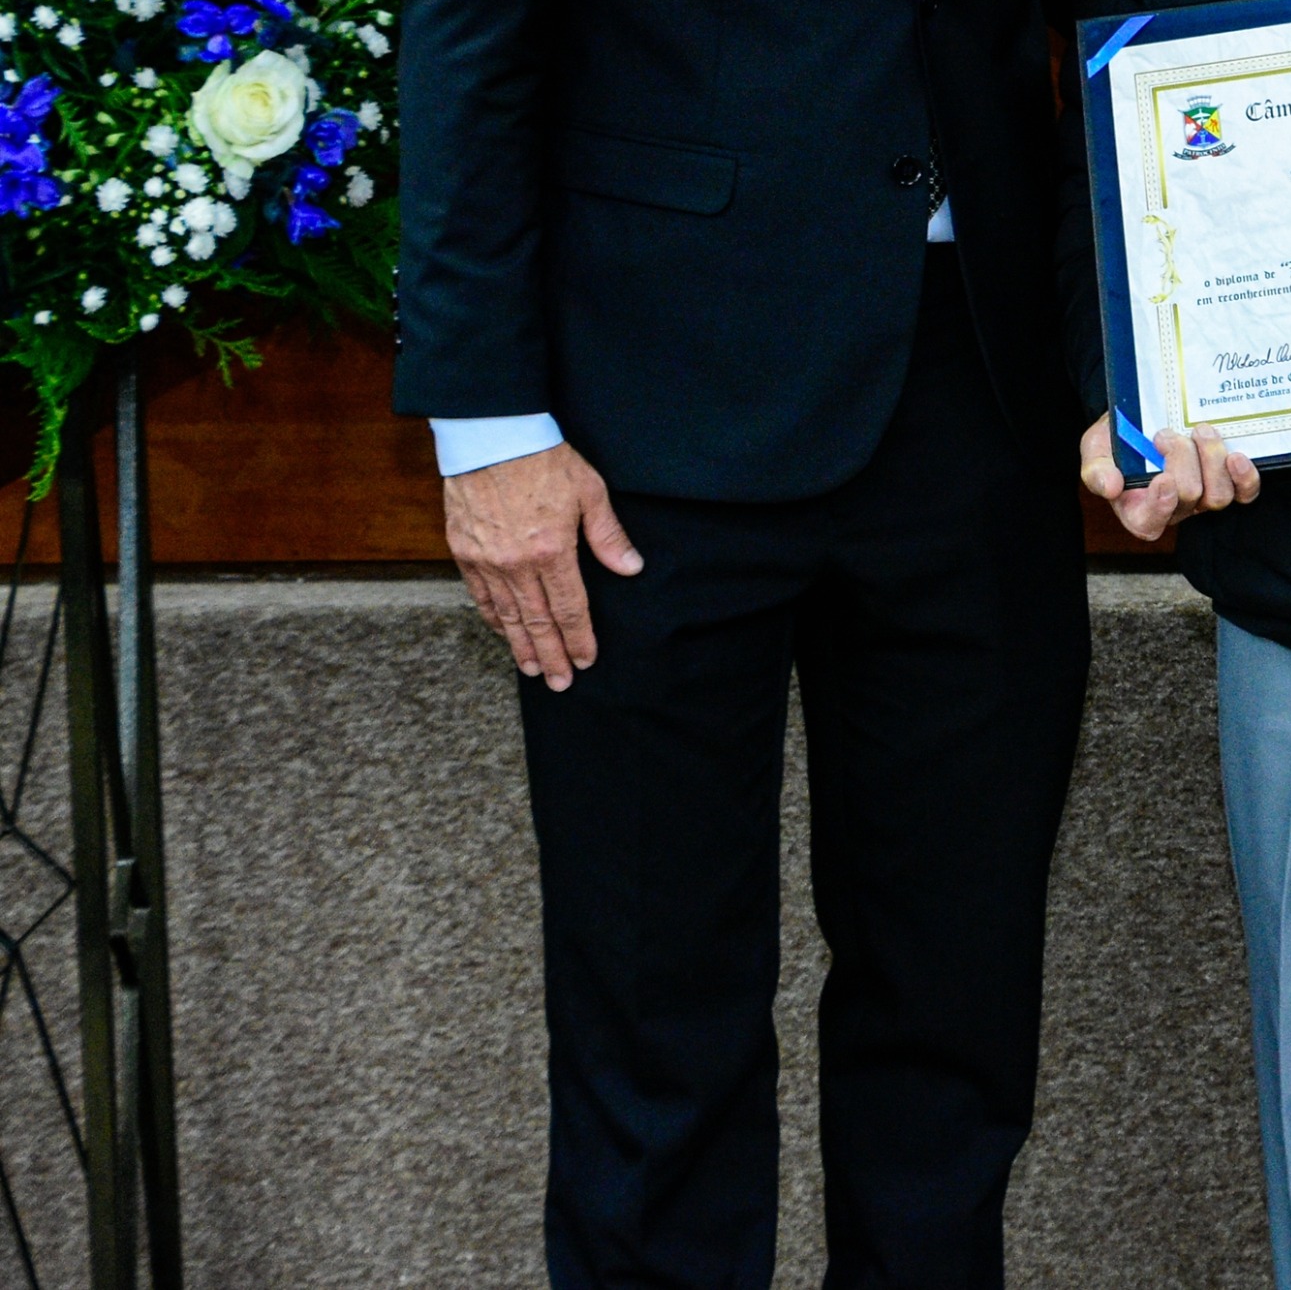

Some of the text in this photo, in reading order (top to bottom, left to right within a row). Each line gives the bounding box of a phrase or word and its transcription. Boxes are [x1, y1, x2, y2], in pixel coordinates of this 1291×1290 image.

[1203, 279, 1210, 288] o
[1215, 273, 1259, 286] diploma
[1263, 270, 1275, 279] de
[1196, 296, 1212, 306] em
[1218, 376, 1268, 393] Nikolas
[1270, 374, 1284, 384] de
[1199, 394, 1243, 407] Presidente
[1245, 392, 1255, 400] da
[1257, 388, 1290, 398] Câmara
